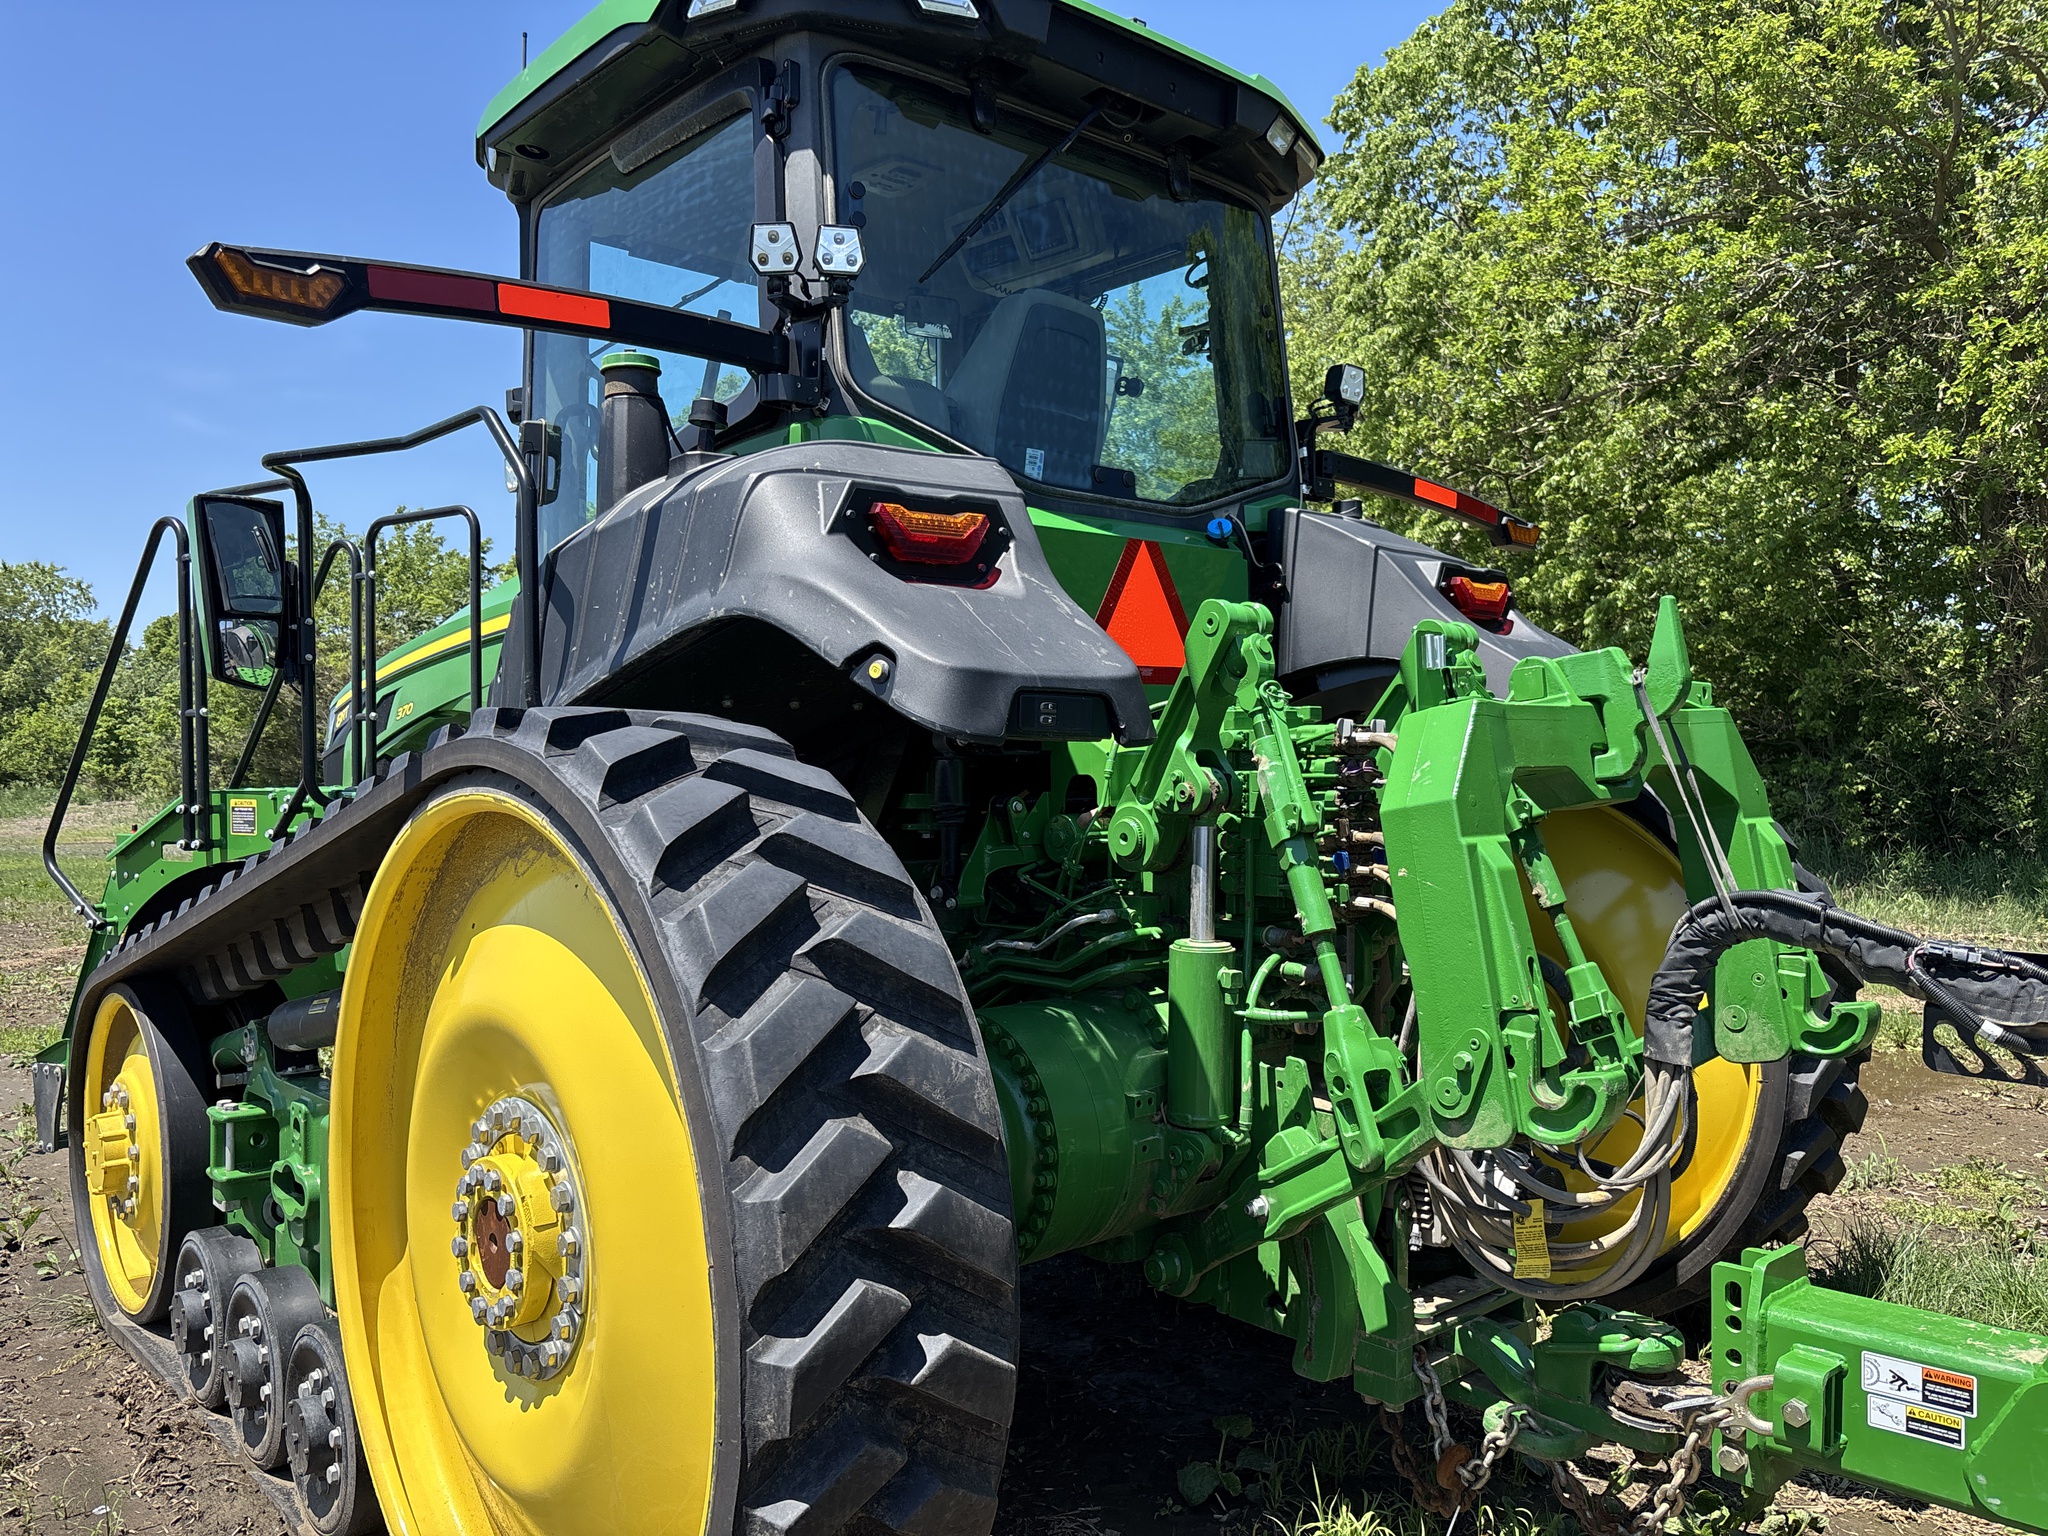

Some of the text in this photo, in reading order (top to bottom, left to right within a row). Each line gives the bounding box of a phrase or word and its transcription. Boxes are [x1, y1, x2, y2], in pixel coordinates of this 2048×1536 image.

[396, 701, 414, 721] 370
[1933, 1372, 1972, 1388] WARNING
[1918, 1410, 1960, 1427] CAUTION
